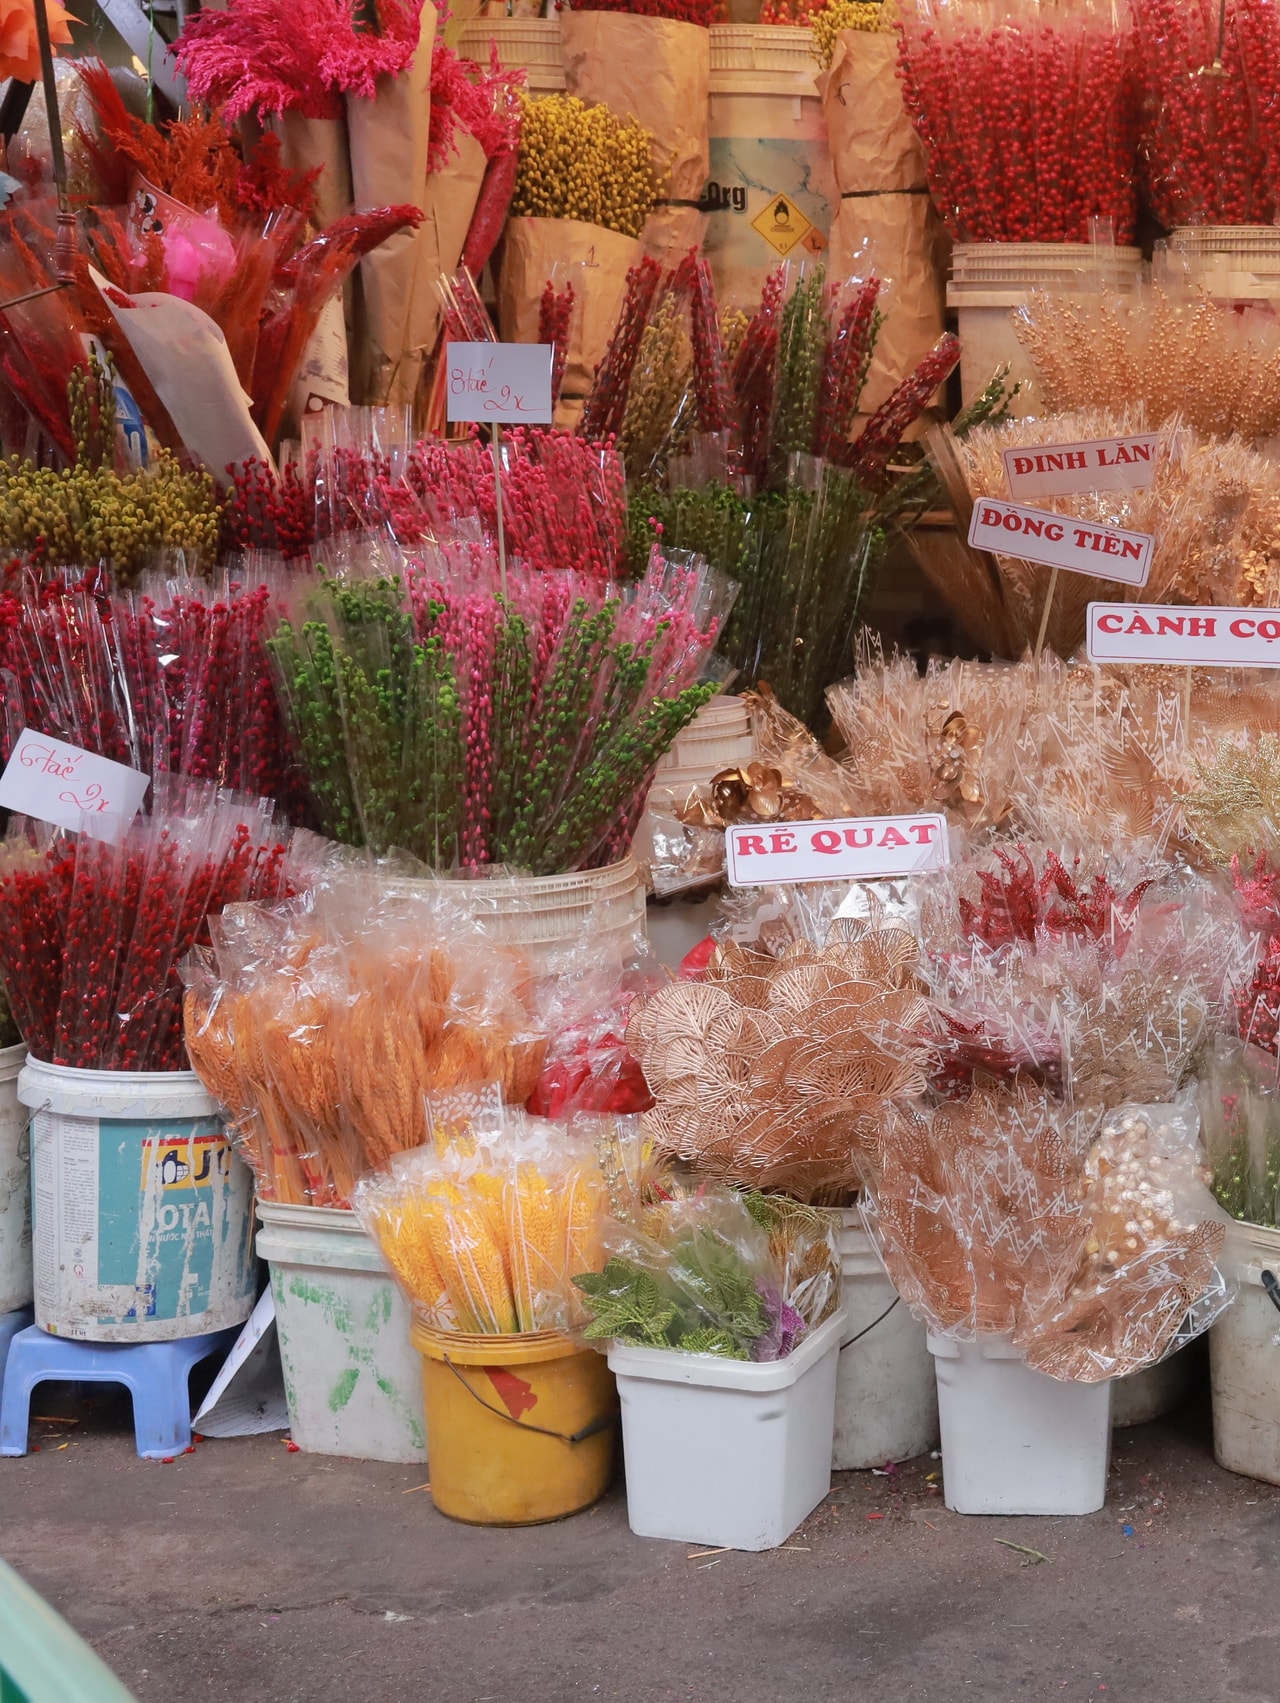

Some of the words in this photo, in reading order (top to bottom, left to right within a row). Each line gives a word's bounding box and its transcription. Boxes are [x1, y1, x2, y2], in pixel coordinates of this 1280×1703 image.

[1013, 451, 1088, 475] ĐINH
[1096, 442, 1171, 467] LĂN
[980, 507, 1064, 542] ĐỒNG
[1073, 529, 1143, 560] TIỀN
[1097, 610, 1217, 637] CÀNH
[736, 828, 798, 856] RẼ
[810, 823, 937, 855] QUẠT
